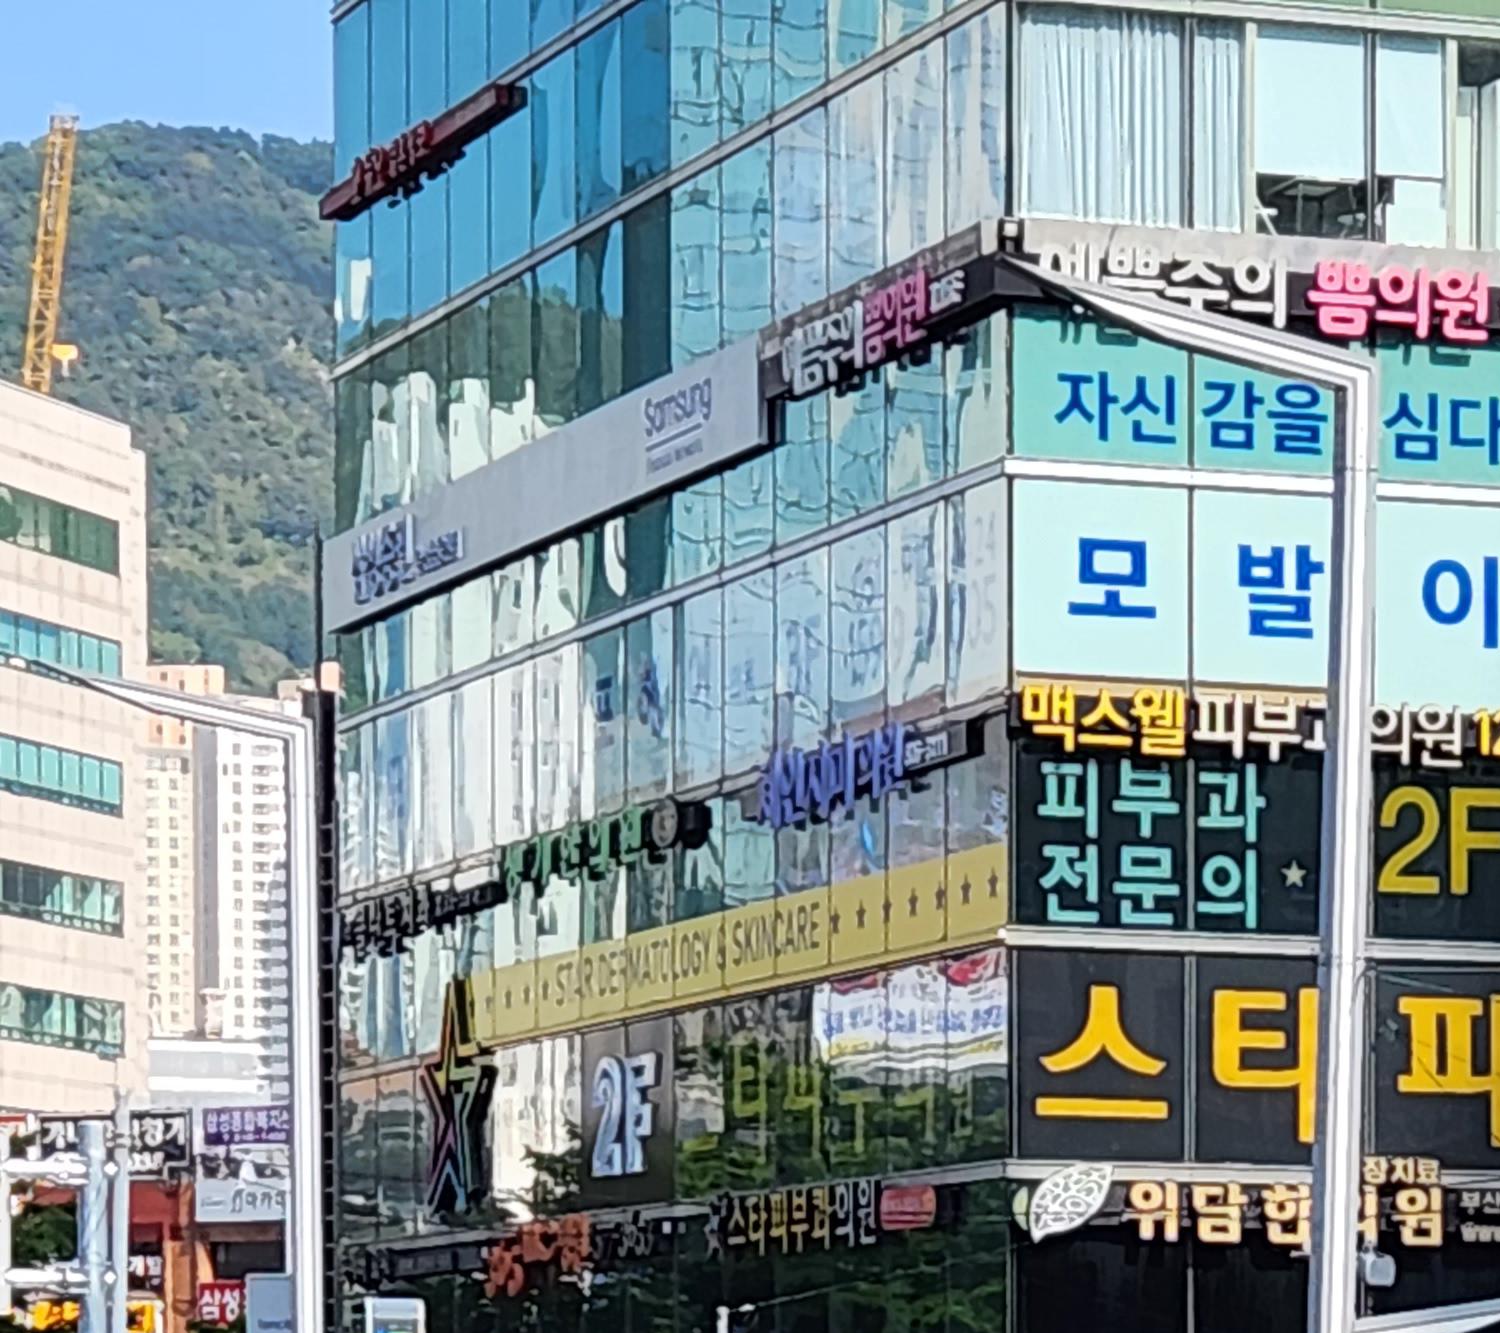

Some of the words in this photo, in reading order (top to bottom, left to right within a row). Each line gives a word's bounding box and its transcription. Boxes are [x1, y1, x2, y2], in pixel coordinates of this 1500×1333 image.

[1307, 258, 1490, 342] 쁨의원
[1054, 370, 1330, 457] 자신감을
[1021, 683, 1186, 759] 맥스웰
[1037, 757, 1266, 843] 피부과
[1037, 844, 1260, 930] 전문의
[731, 901, 821, 967] SKINCARE
[592, 1052, 657, 1178] 2F
